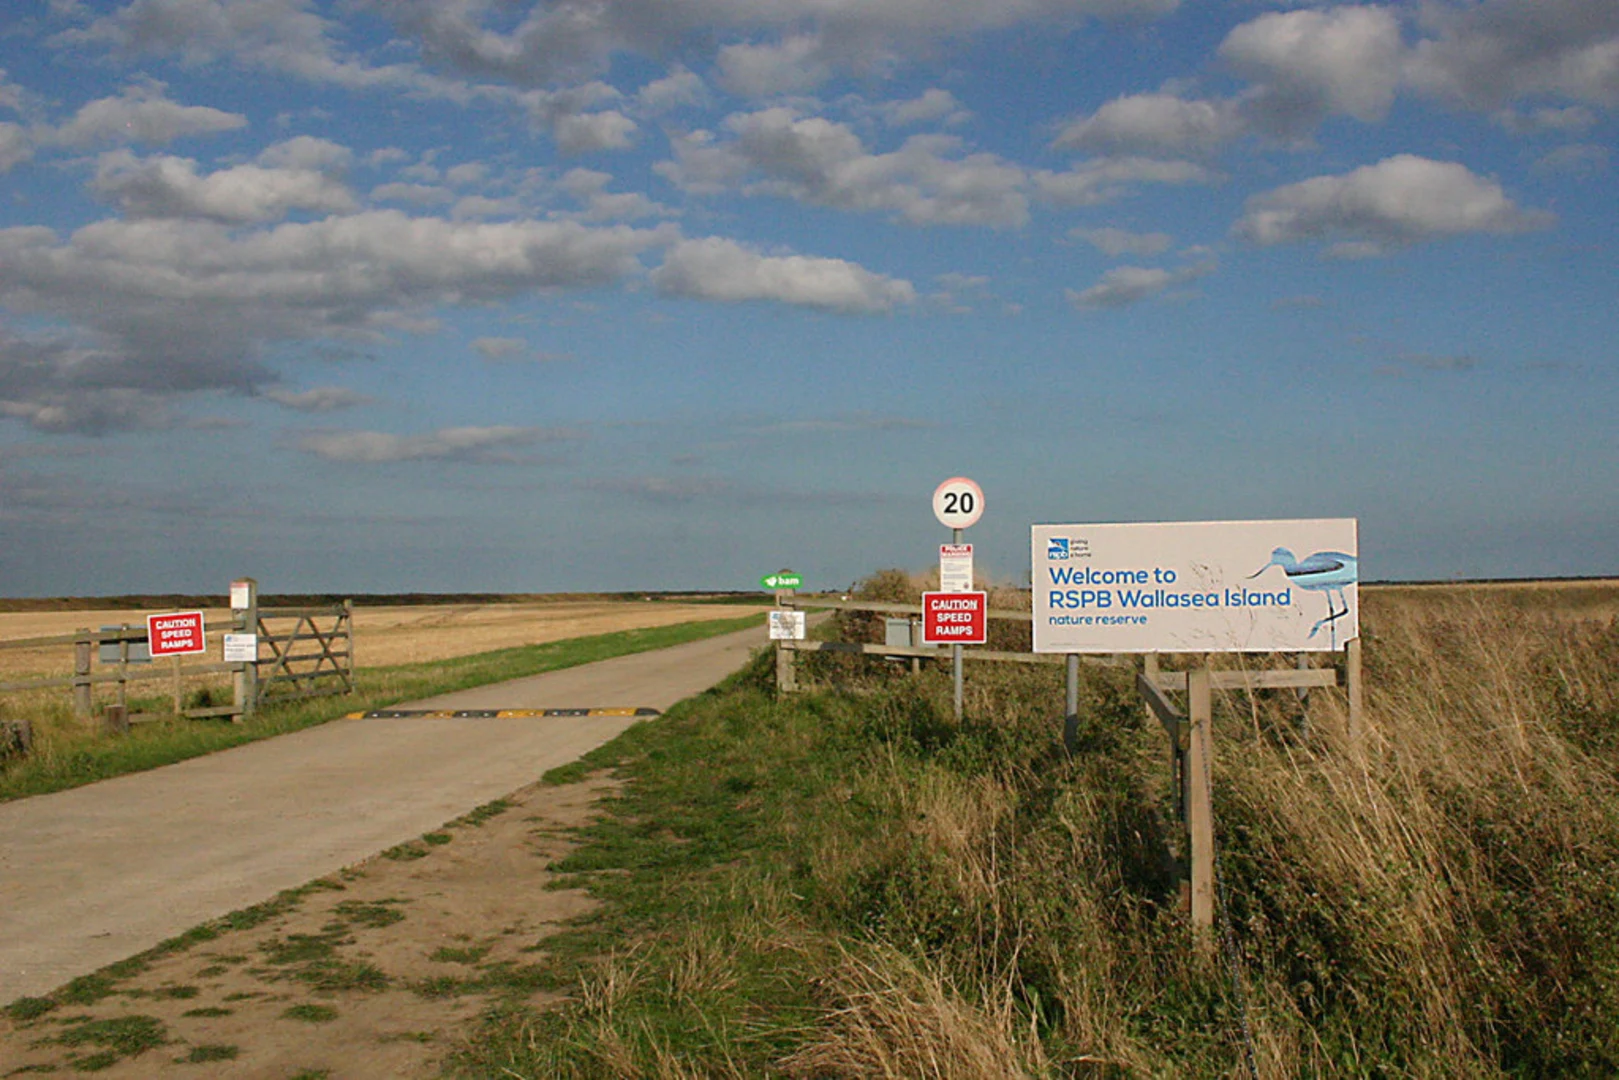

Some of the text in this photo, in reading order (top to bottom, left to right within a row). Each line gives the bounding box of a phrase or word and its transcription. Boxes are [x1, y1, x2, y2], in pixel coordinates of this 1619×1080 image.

[944, 492, 974, 514] 20
[778, 576, 800, 585] bam
[1049, 567, 1177, 584] Welcome to
[1049, 587, 1291, 608] RSPB Wallasea Island
[931, 599, 978, 610] CAUTION
[937, 612, 972, 622] SPEED
[1049, 615, 1148, 625] nature reserve
[155, 618, 197, 630] CAUTION
[161, 629, 193, 640] SPEED
[935, 625, 973, 636] RAMPS
[161, 639, 194, 649] RAMPS
